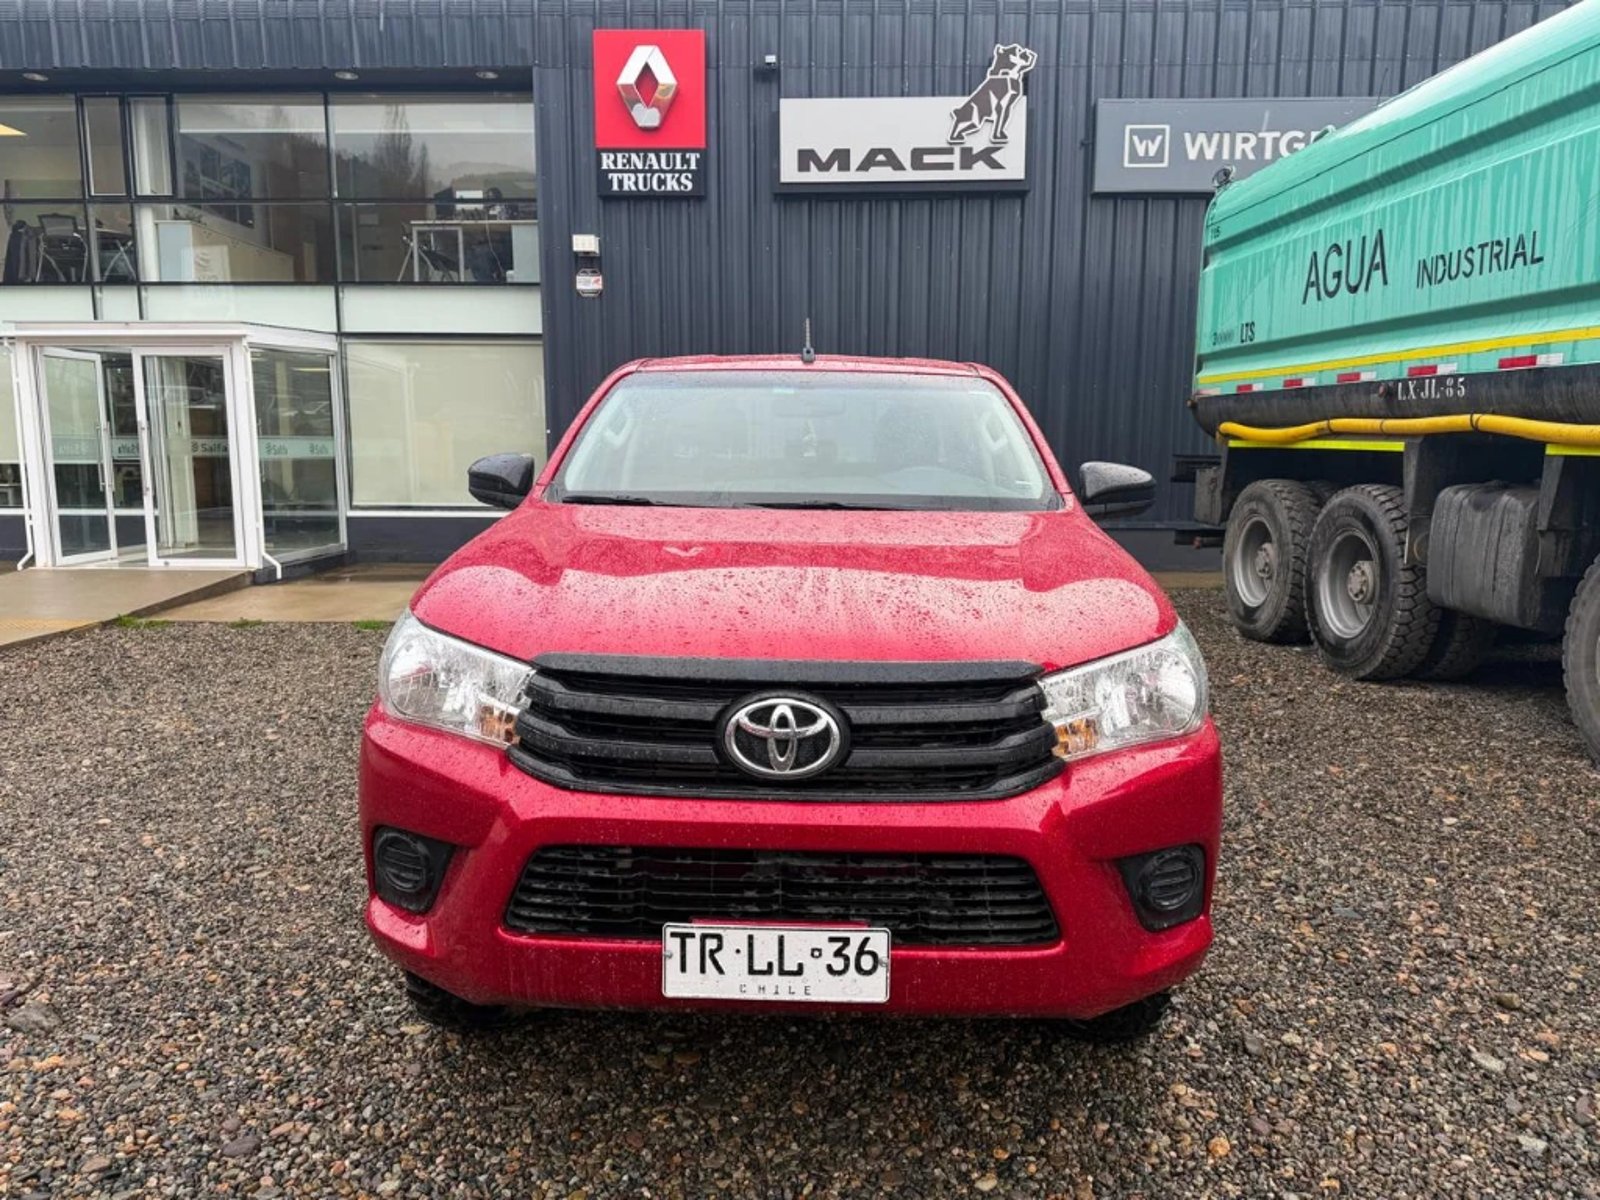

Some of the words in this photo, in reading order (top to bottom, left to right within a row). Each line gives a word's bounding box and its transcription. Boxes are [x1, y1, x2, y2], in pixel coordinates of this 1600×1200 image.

[600, 152, 700, 171] RENAULT
[797, 146, 1007, 173] MACK
[608, 173, 693, 192] TRUCKS
[1302, 228, 1389, 305] AGUA
[1416, 230, 1545, 289] INDUSTRIAL
[1239, 321, 1256, 344] LTS
[739, 983, 811, 996] CHILE
